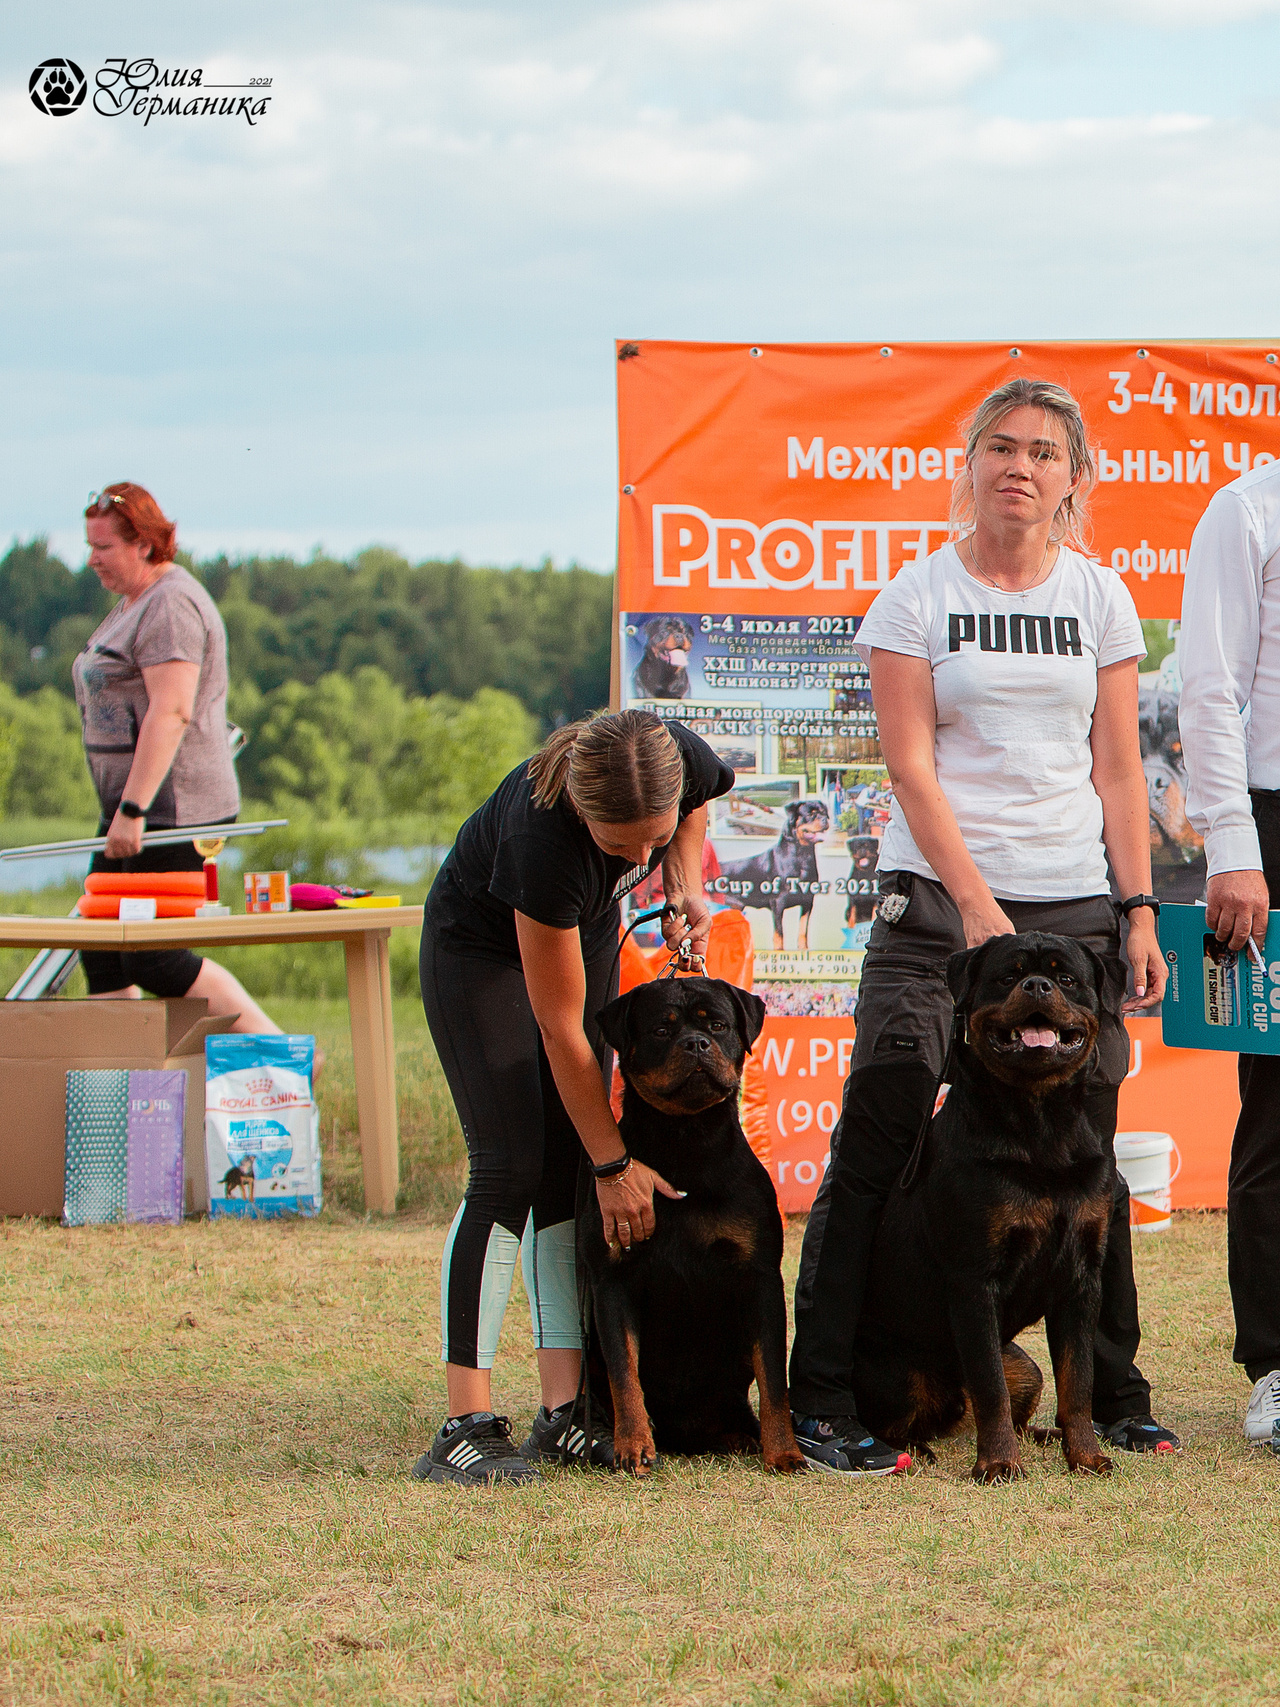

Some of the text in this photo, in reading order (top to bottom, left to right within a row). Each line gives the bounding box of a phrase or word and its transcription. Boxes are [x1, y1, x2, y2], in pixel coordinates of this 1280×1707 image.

[1107, 371, 1177, 415] 3-4
[700, 615, 856, 635] 3-4 июля 2021
[708, 635, 747, 645] Место
[753, 637, 831, 647] проведения
[949, 613, 1083, 656] PUMA
[729, 644, 756, 654] база
[812, 645, 859, 656] «Волжа
[752, 658, 869, 675] Межрегионал
[705, 672, 871, 690] Чемпионат Ротвейл
[720, 707, 842, 723] монопородная
[713, 721, 750, 735] КЧК
[770, 721, 833, 736] особым
[704, 877, 754, 897] «Cup
[760, 877, 780, 894] of
[786, 877, 829, 894] Tver
[808, 964, 857, 974] +7-903
[1208, 981, 1218, 1005] Silver
[1210, 1006, 1219, 1024] CUP
[1252, 1002, 1268, 1033] CUP
[220, 1092, 297, 1109] ROYAL CANIN
